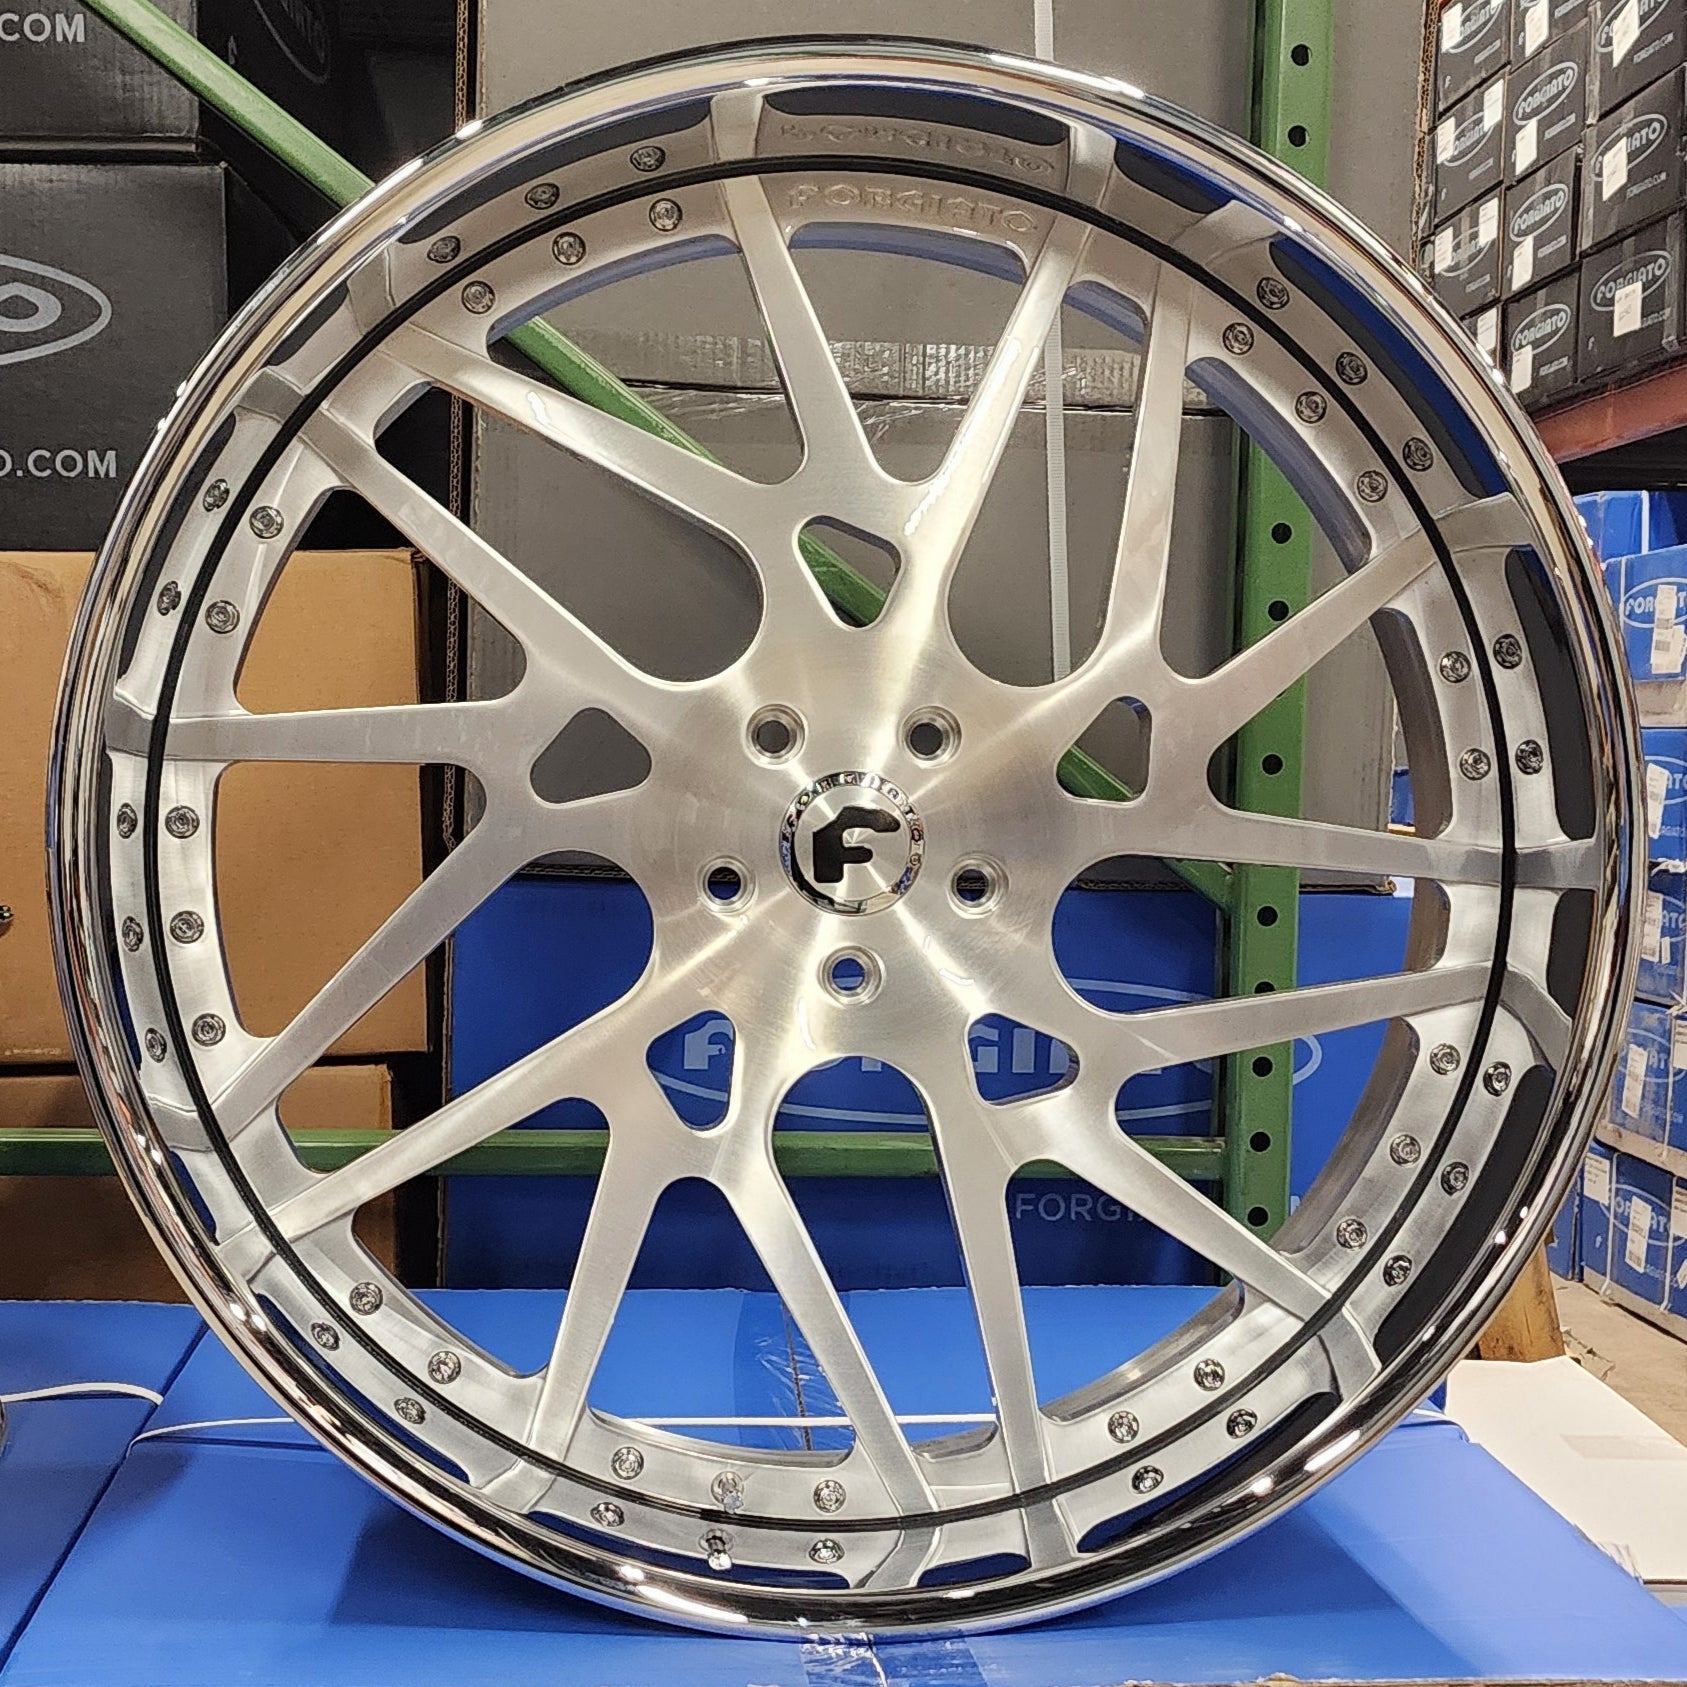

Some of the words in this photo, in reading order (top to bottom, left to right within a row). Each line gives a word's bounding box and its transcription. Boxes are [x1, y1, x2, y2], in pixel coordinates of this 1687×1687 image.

[1517, 68, 1574, 118] FORGIATO
[788, 183, 1038, 233] FORGIATO
[1513, 189, 1565, 235] FORGIATO
[1515, 311, 1567, 349] FORGIATO
